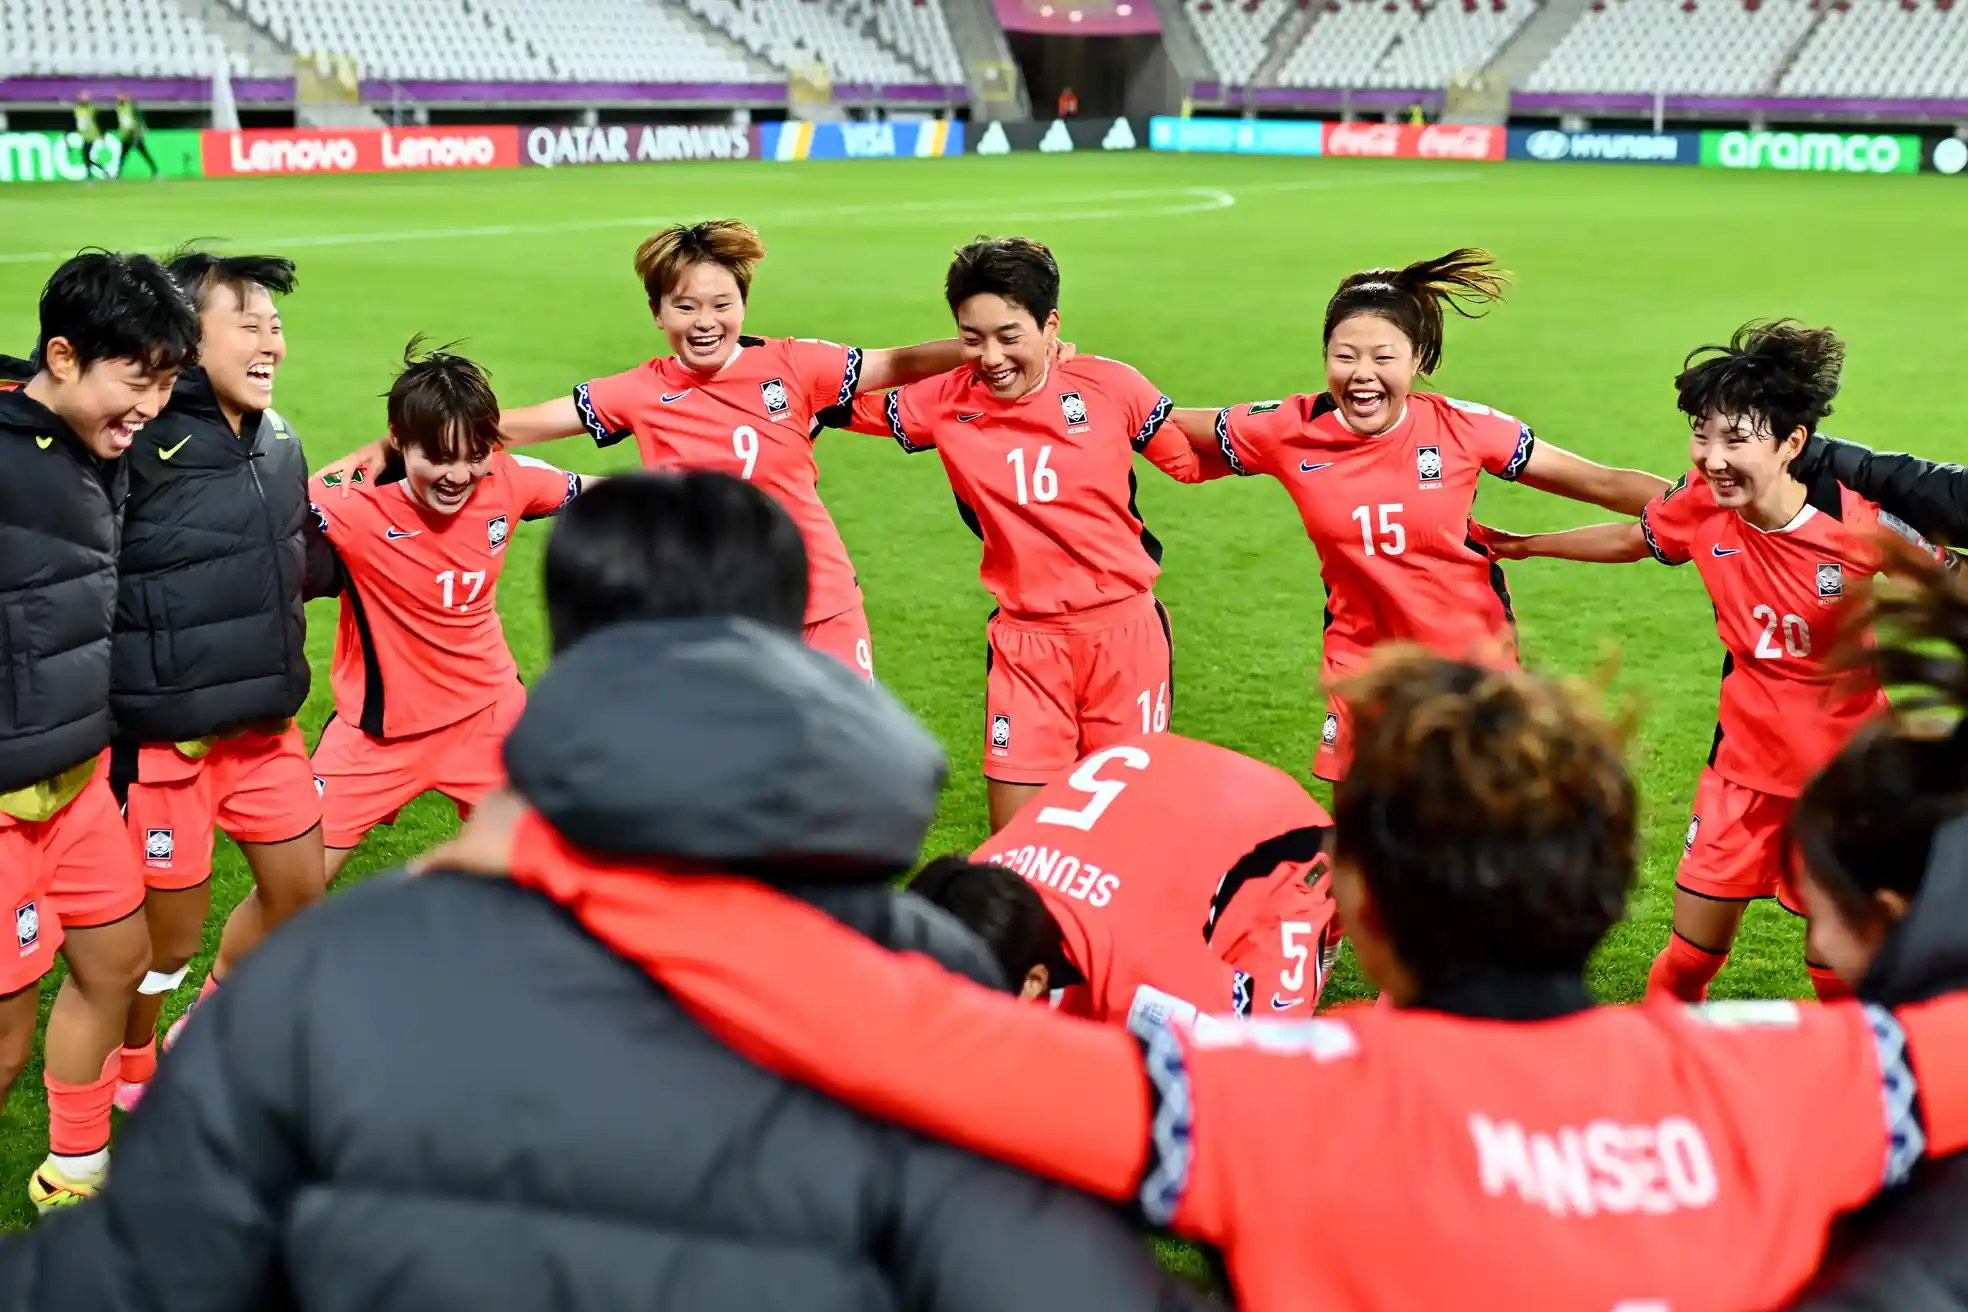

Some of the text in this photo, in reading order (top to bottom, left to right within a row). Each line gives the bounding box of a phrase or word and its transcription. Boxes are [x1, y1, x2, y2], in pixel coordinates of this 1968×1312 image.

[230, 129, 494, 171] Lenovo Lenovo
[527, 124, 750, 168] QATAR AIRWAYS
[1718, 131, 1900, 173] aramco
[732, 424, 759, 481] 9
[1002, 444, 1058, 506] 16
[1352, 503, 1407, 557] 15
[435, 569, 487, 613] 17
[1752, 603, 1812, 660] 20
[1136, 680, 1166, 735] 16
[1036, 746, 1151, 832] 5
[1280, 921, 1312, 991] 5
